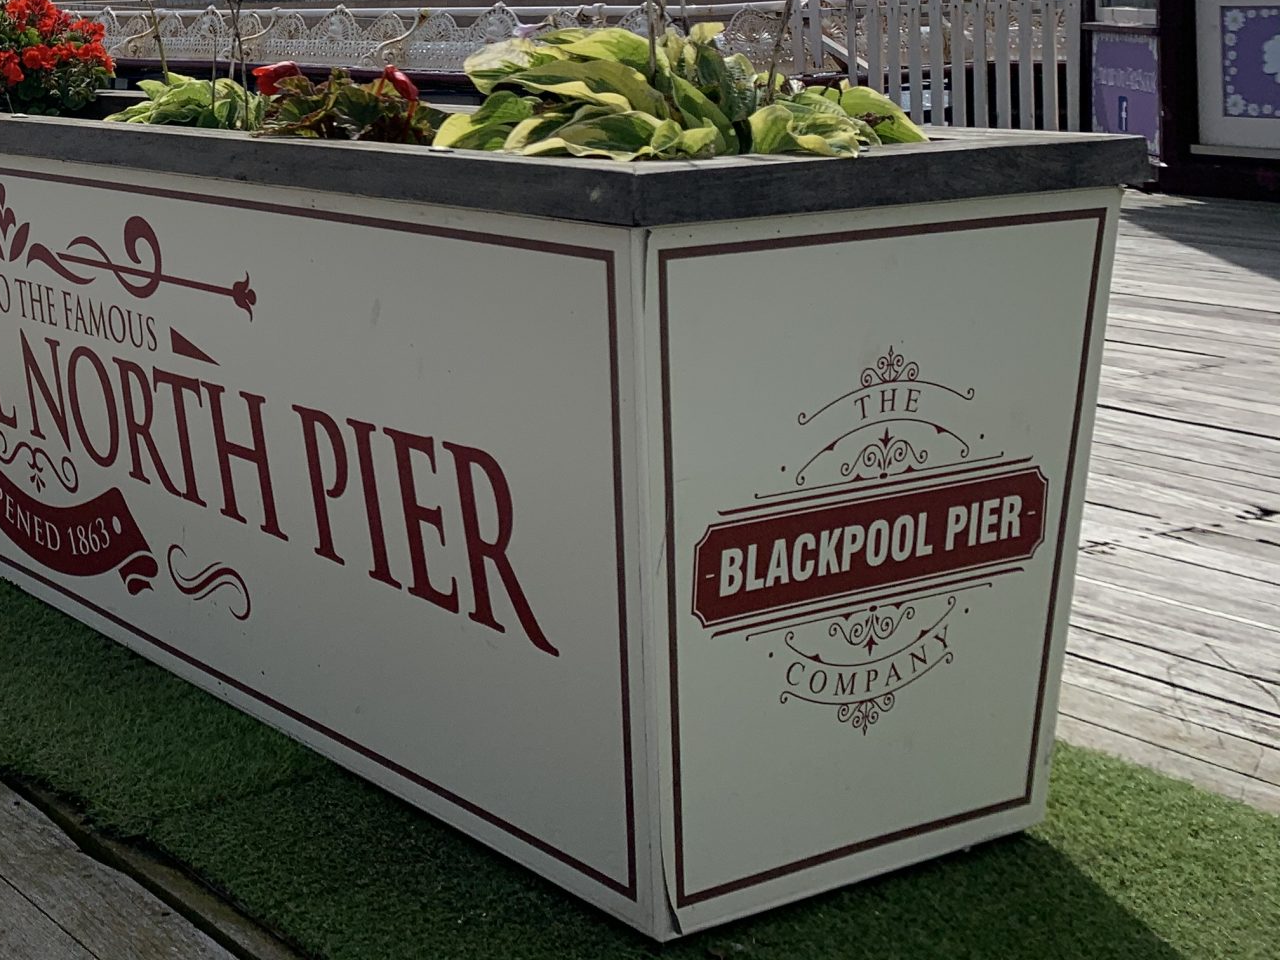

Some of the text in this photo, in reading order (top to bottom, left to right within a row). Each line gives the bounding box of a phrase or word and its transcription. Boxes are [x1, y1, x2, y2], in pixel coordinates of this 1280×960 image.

[14, 278, 57, 327] THE
[61, 290, 158, 352] FAMOUS
[853, 388, 922, 422] THE
[19, 327, 289, 541] NORTH
[291, 404, 560, 657] PIER
[67, 517, 111, 555] 1863
[719, 495, 1023, 598] BLACKPOOL PIER
[785, 624, 952, 697] COMPANY
